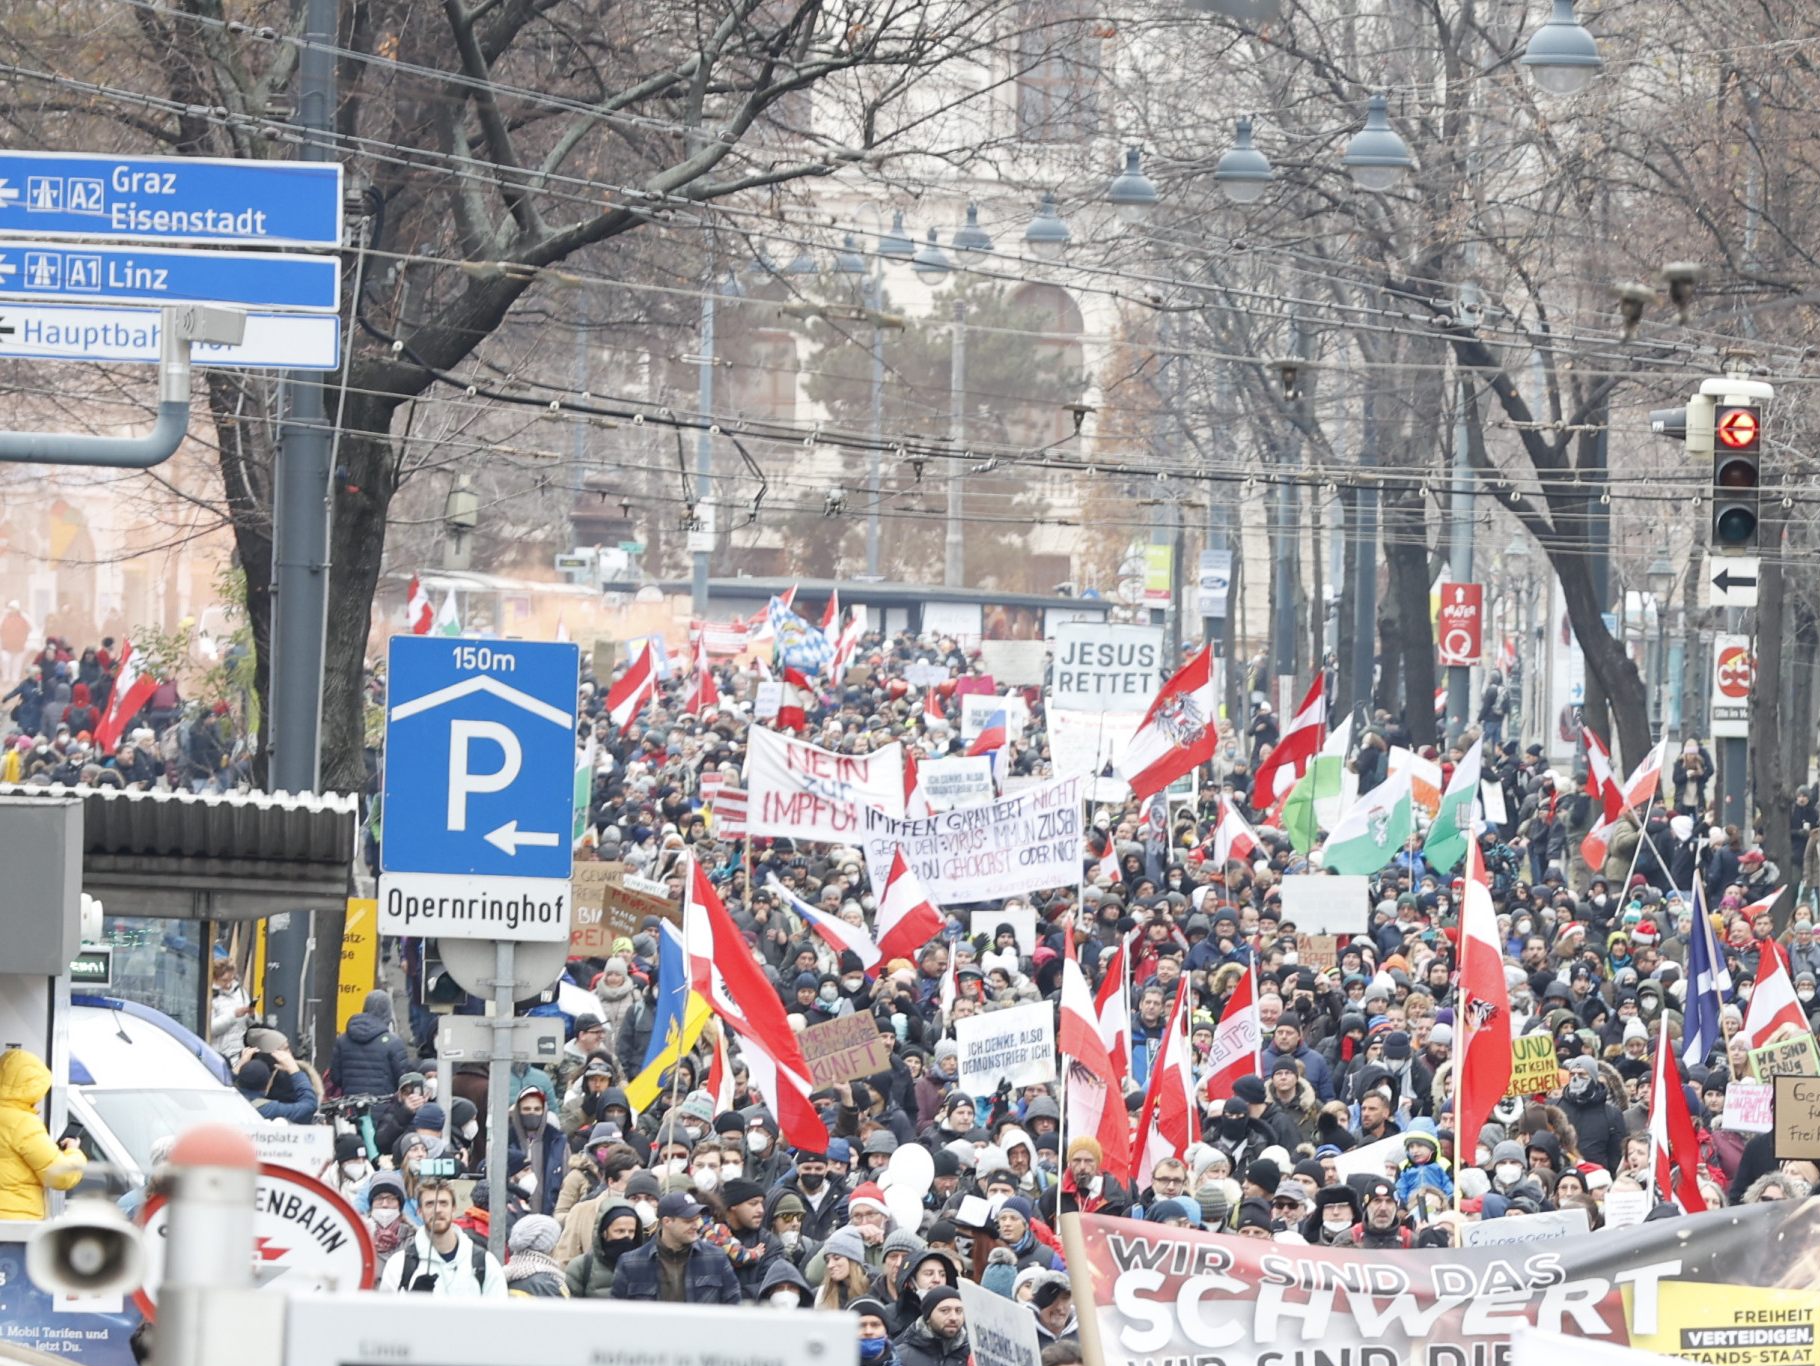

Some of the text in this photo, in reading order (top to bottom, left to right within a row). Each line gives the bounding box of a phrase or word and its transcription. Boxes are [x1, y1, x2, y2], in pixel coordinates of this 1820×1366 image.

[112, 165, 177, 195] Graz
[70, 181, 102, 210] A2
[111, 202, 268, 235] Eisenstadt
[70, 262, 99, 286] A1
[109, 260, 169, 290] Linz
[452, 646, 516, 672] 150m
[1061, 641, 1156, 668] JESUS
[1058, 671, 1153, 695] RETTET
[446, 718, 523, 832] P
[785, 743, 869, 784] NEIN
[387, 887, 564, 930] Opernringhof
[967, 1042, 982, 1057] ICH
[1019, 1028, 1043, 1043] ALSO
[1512, 1035, 1553, 1060] UND
[1528, 1059, 1554, 1073] KEIN
[1107, 1234, 1566, 1300] WIR SIND DAS
[1113, 1258, 1684, 1355] SCHWERT
[1734, 1308, 1814, 1324] FREIHEIT
[7, 1325, 110, 1341] Mobil Tarifen und
[1688, 1327, 1814, 1347] VERTEIDIGEN.
